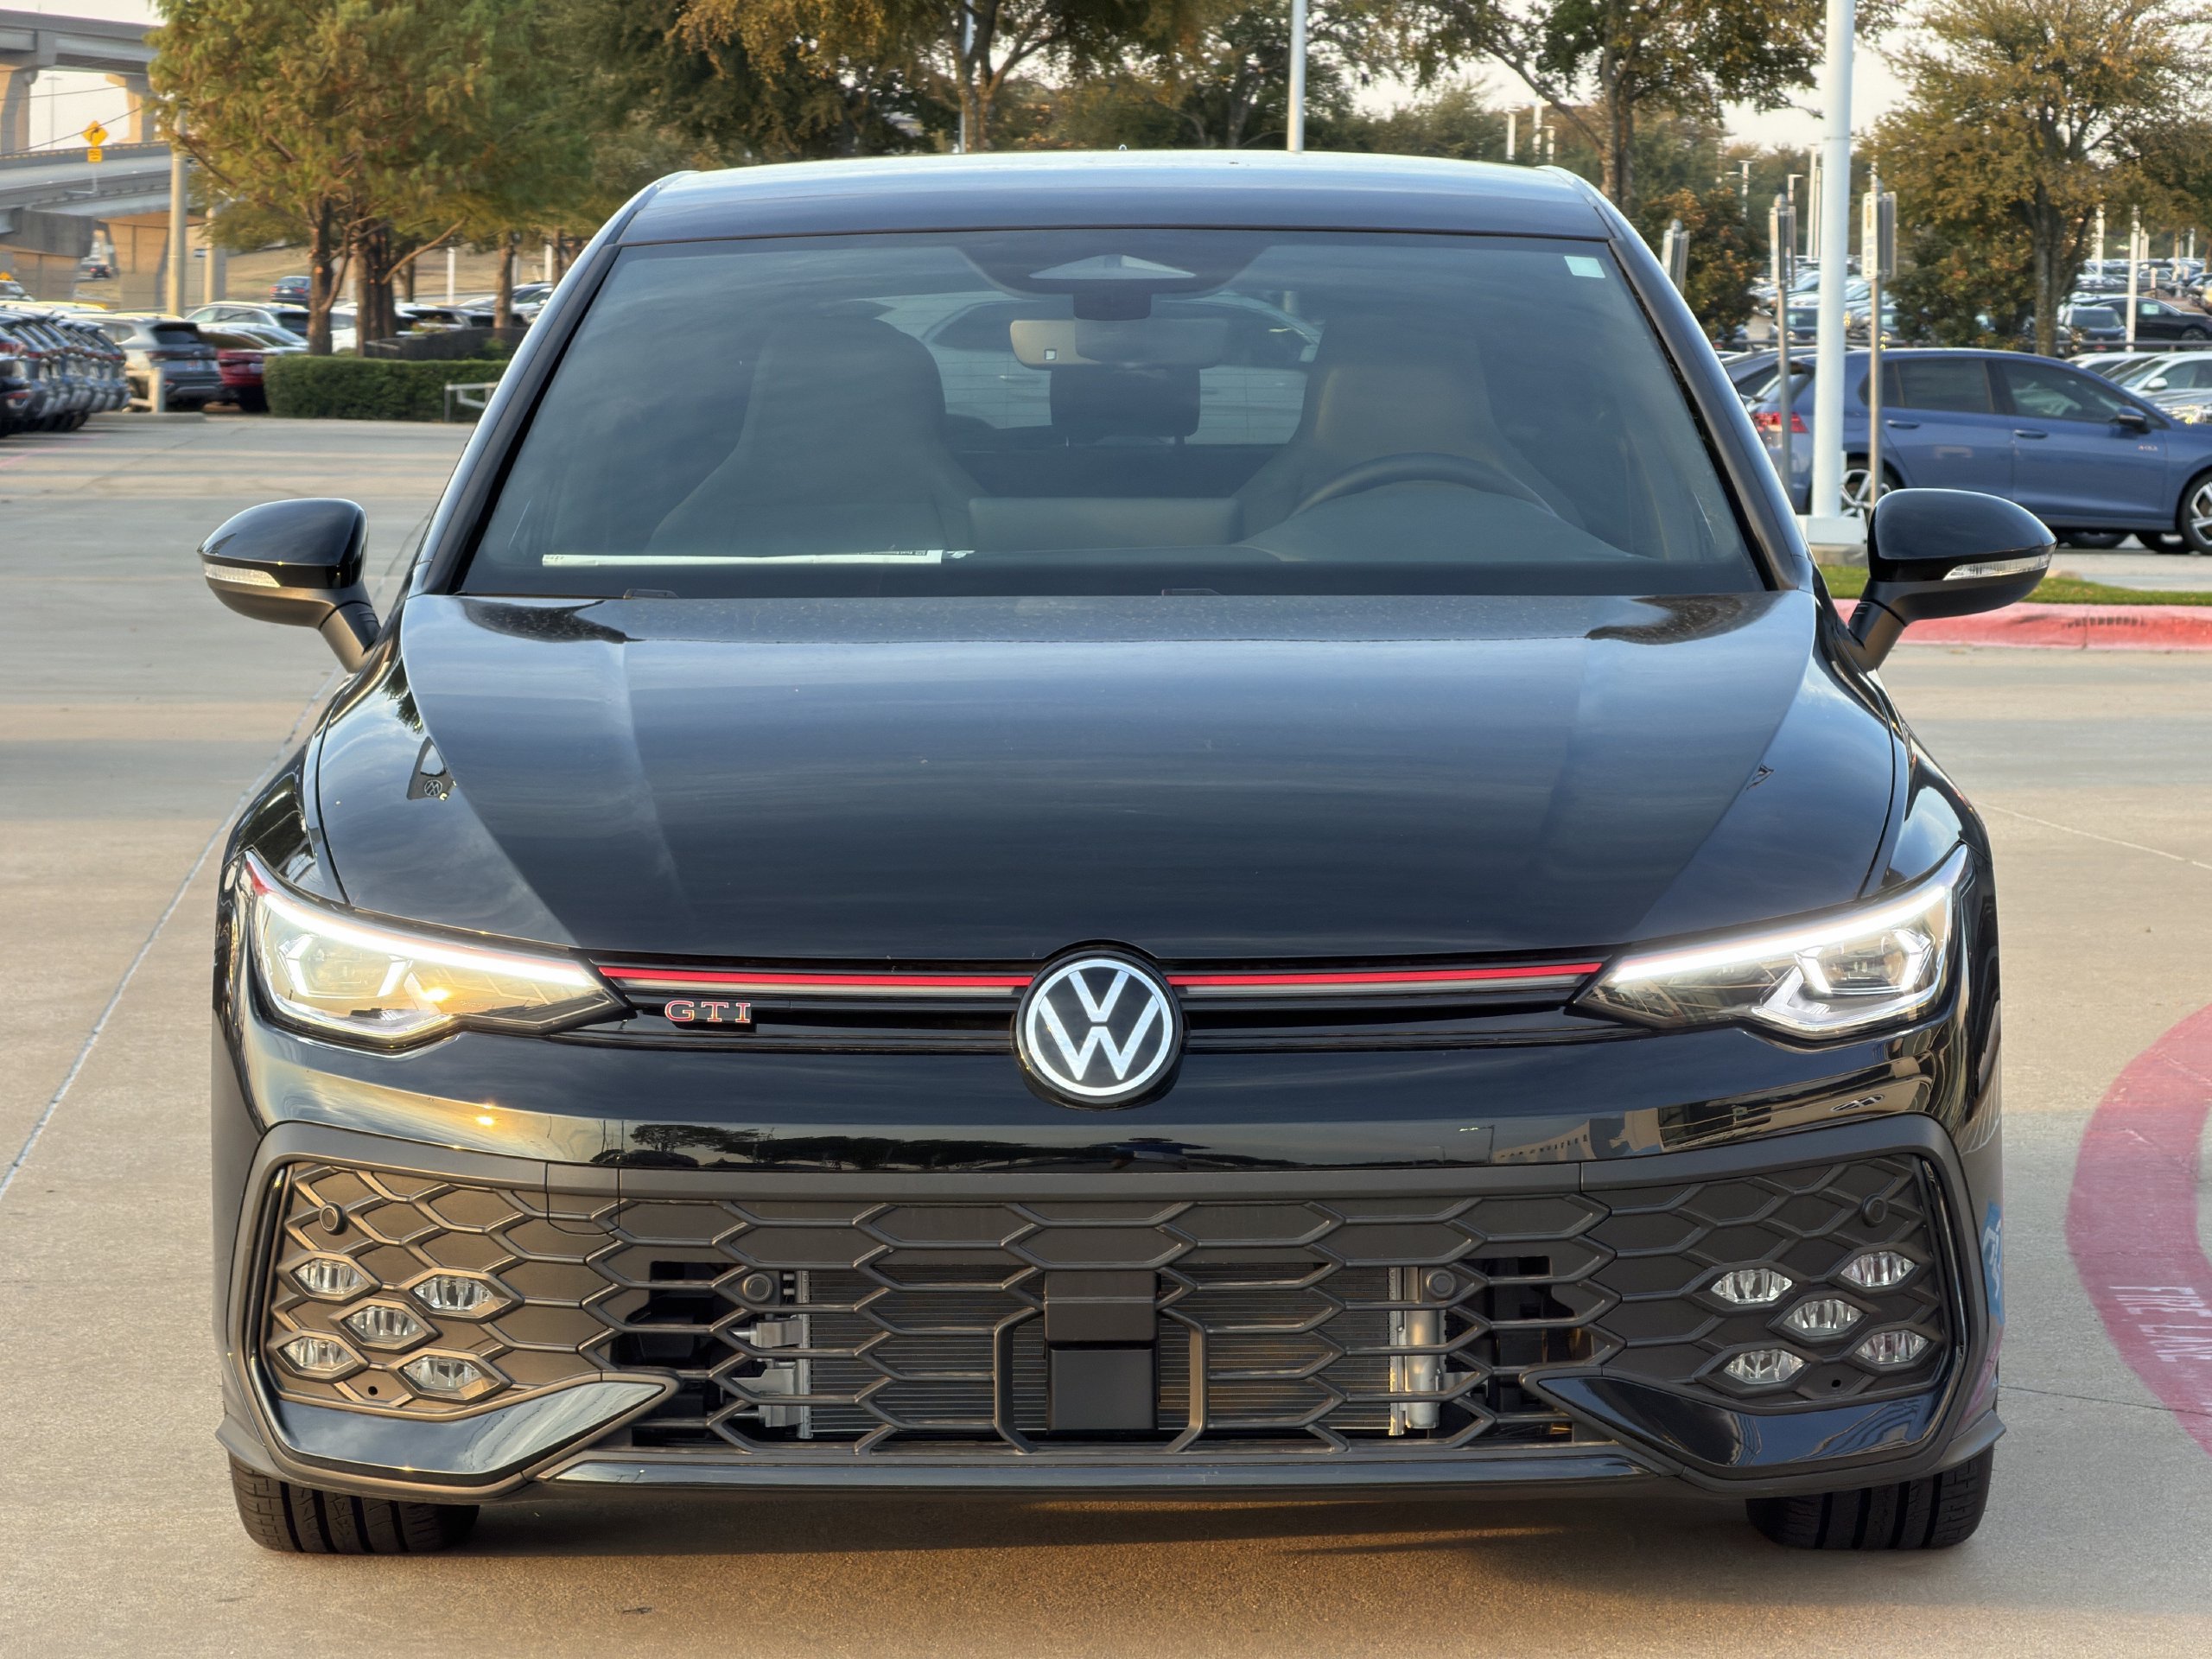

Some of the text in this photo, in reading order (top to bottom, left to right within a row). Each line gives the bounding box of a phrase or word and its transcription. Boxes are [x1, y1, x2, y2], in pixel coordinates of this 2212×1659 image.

[664, 1000, 751, 1023] GTI
[1037, 969, 1160, 1081] VW
[2108, 1285, 2212, 1318] FIRE
